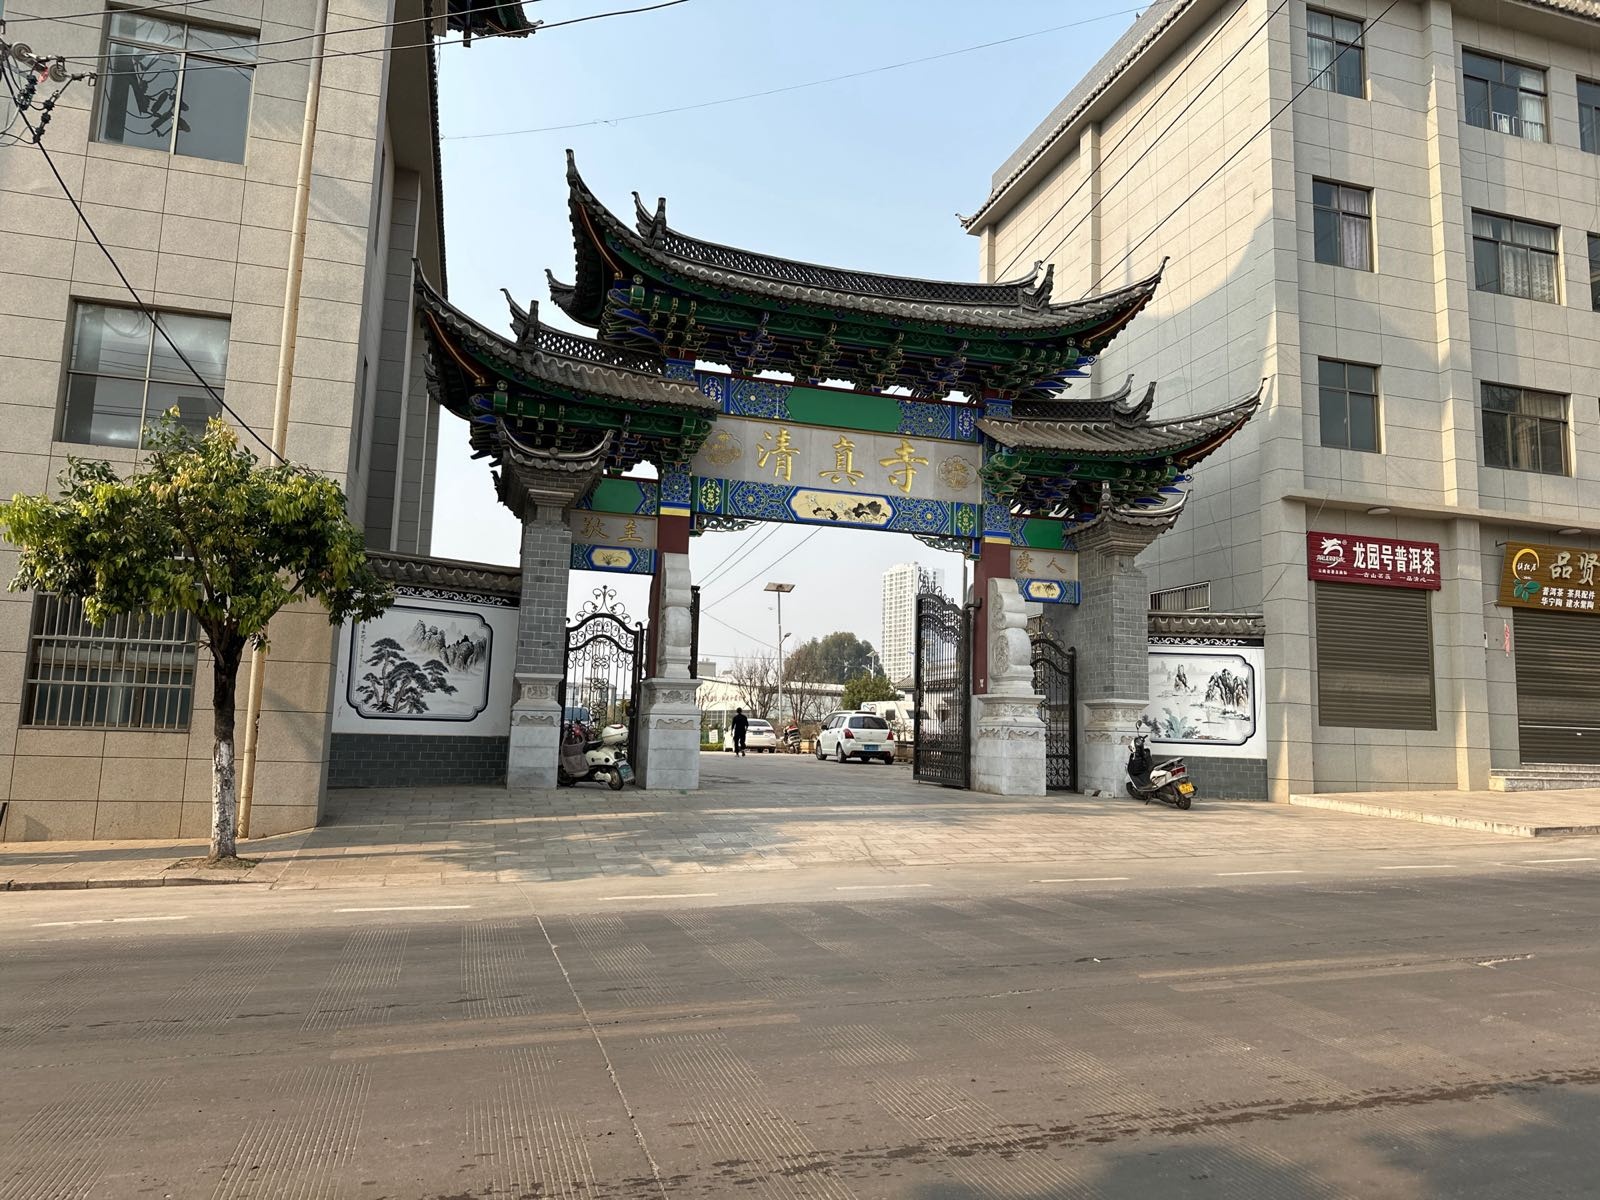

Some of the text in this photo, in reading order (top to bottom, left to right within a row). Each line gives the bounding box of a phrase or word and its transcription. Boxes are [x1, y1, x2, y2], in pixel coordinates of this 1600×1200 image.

[756, 427, 929, 494] 清真寺
[1353, 541, 1435, 575] 龙园号普洱茶
[1541, 597, 1563, 607] 华宁陶
[1542, 586, 1596, 600] 普洱茶 茶具配件
